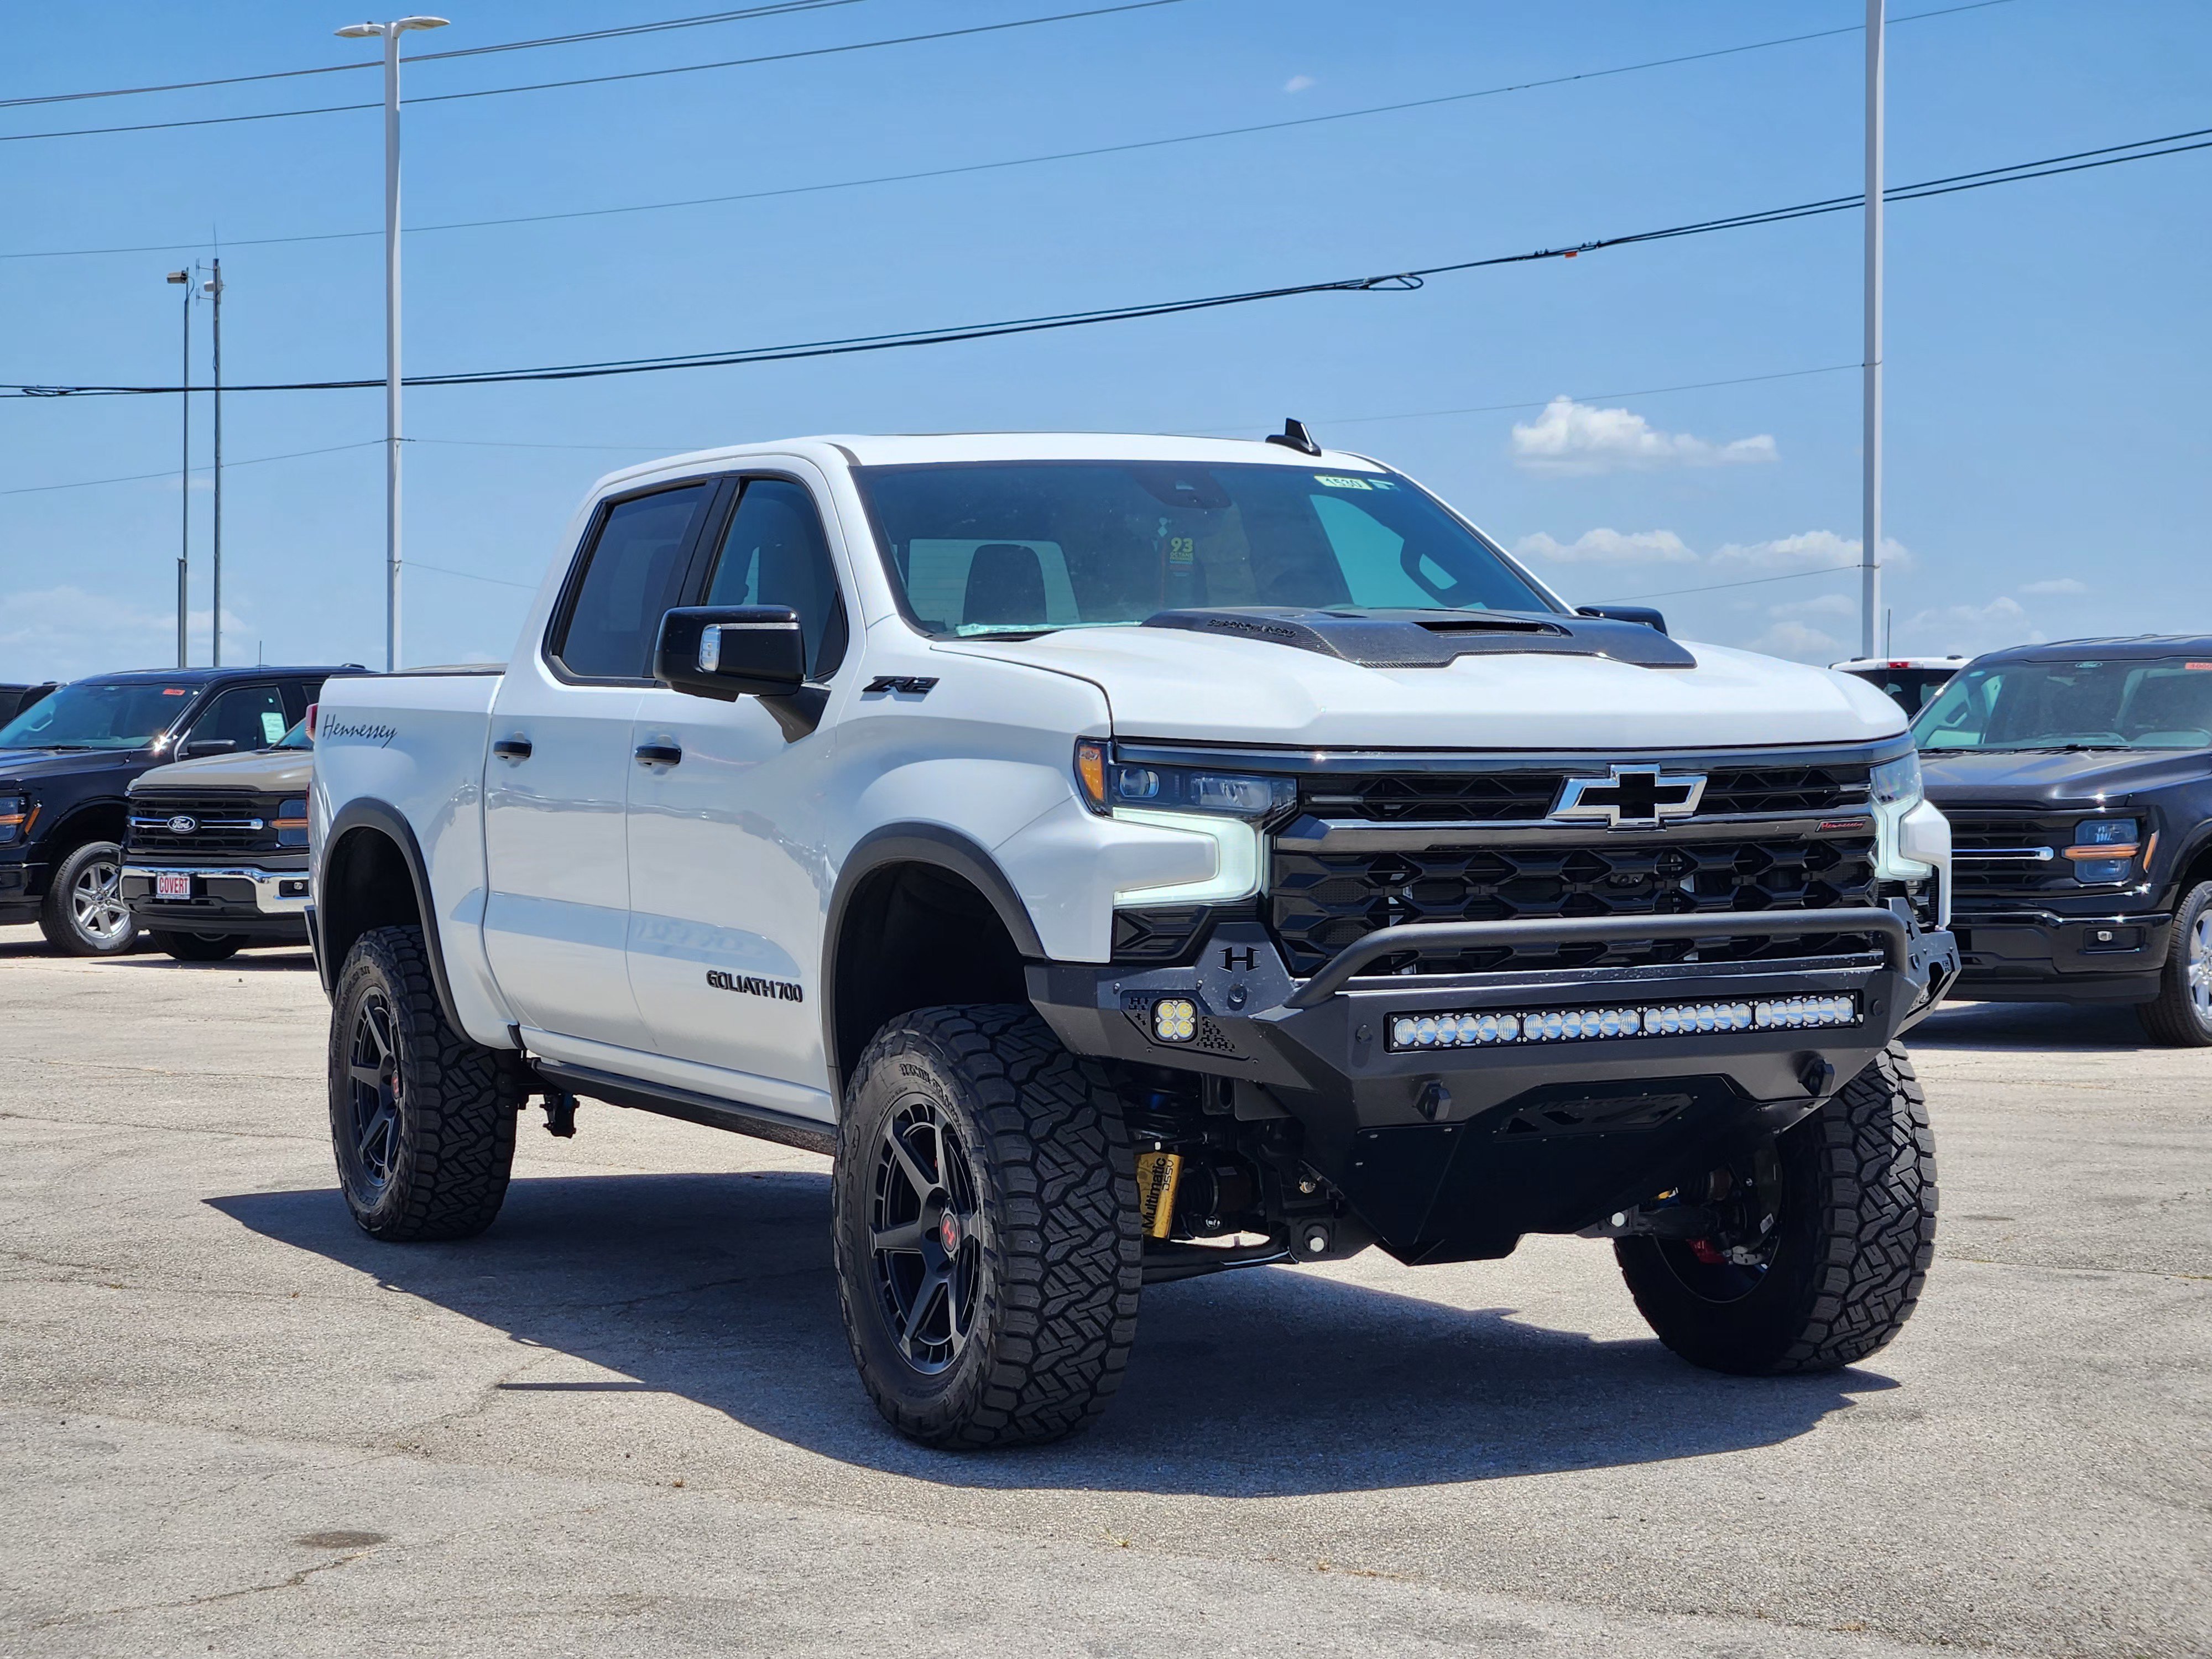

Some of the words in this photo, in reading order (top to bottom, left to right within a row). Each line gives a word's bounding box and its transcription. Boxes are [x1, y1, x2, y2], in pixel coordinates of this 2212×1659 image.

[1171, 537, 1193, 552] 93
[862, 676, 941, 695] ZR2
[322, 714, 398, 749] Hennessey
[159, 877, 189, 894] COVERT
[706, 970, 776, 999] GOLIATH
[775, 981, 804, 1003] 700
[1163, 1159, 1175, 1191] DSSV
[1141, 1157, 1167, 1229] Multimatic
